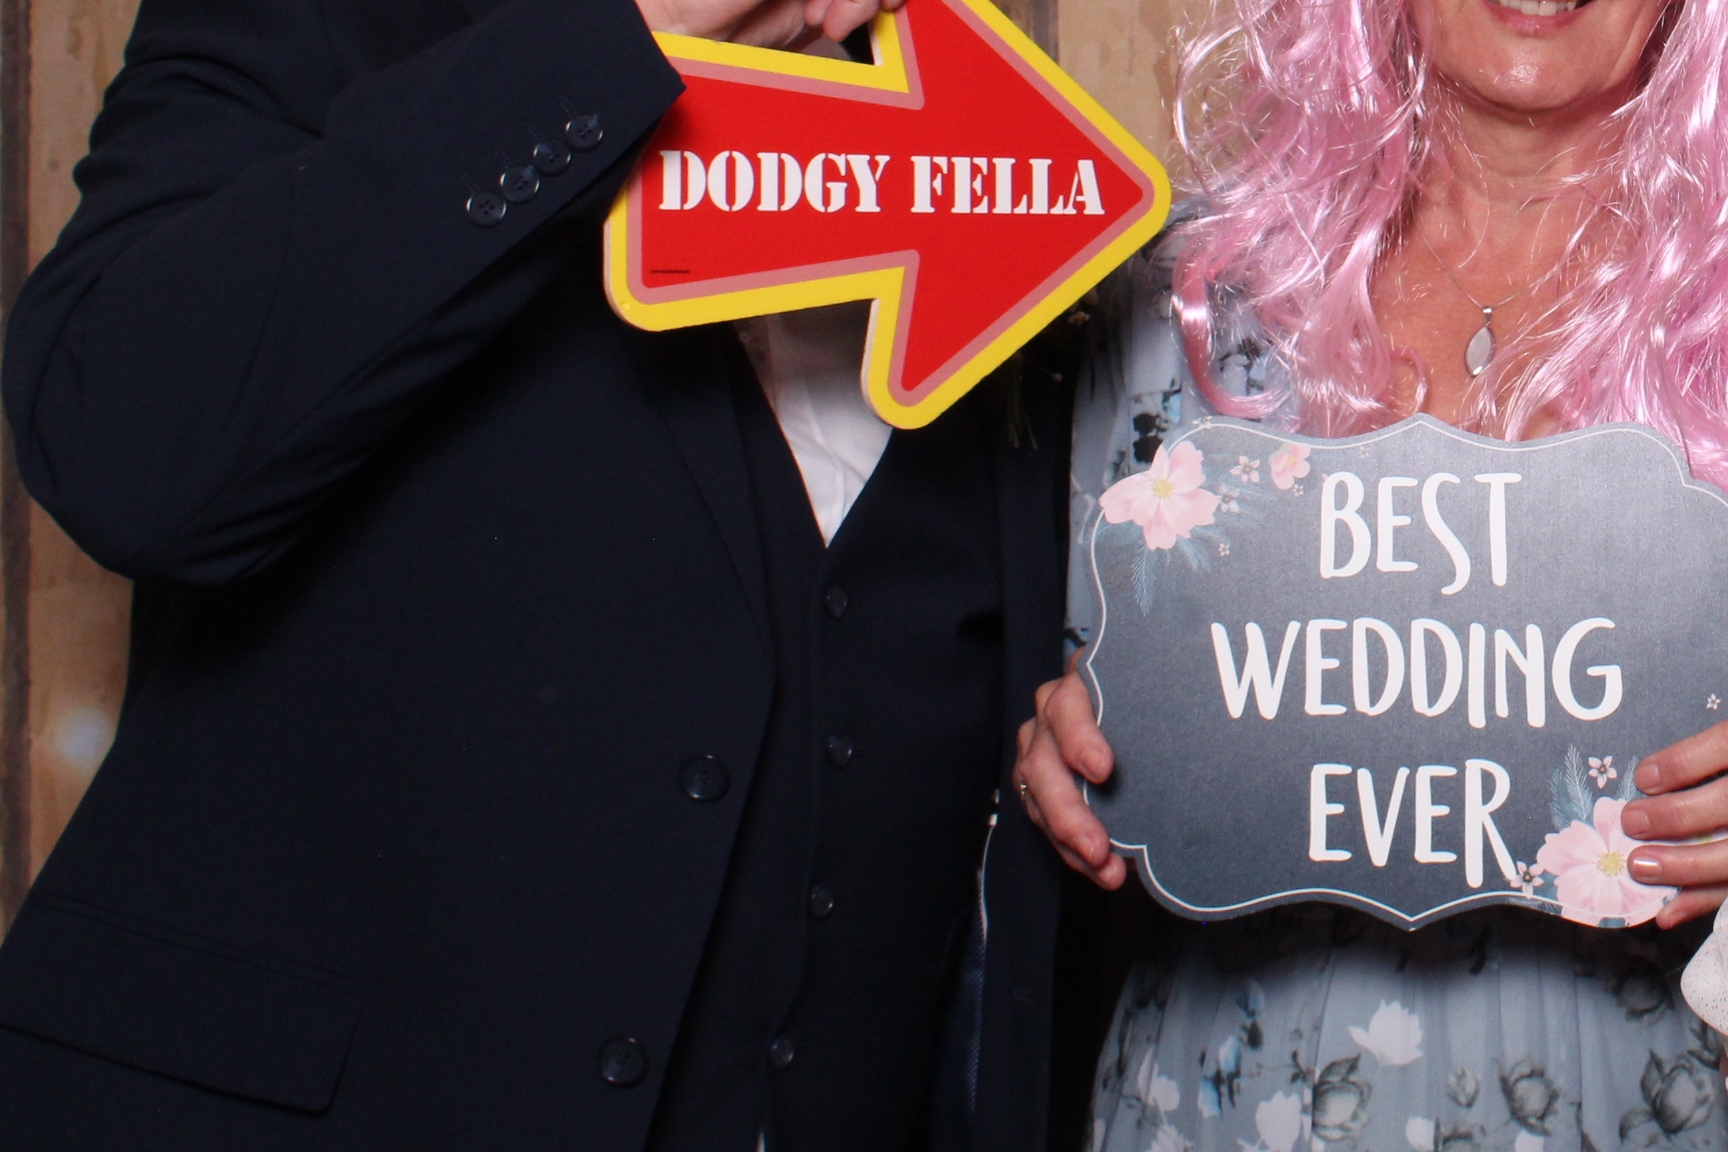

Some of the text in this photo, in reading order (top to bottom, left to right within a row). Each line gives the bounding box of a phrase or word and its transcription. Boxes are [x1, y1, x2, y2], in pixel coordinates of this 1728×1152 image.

[659, 150, 1106, 215] DODGY FELLA
[1319, 471, 1523, 595] BEST
[1211, 617, 1623, 728] WEDDING
[1309, 759, 1518, 888] EVER
